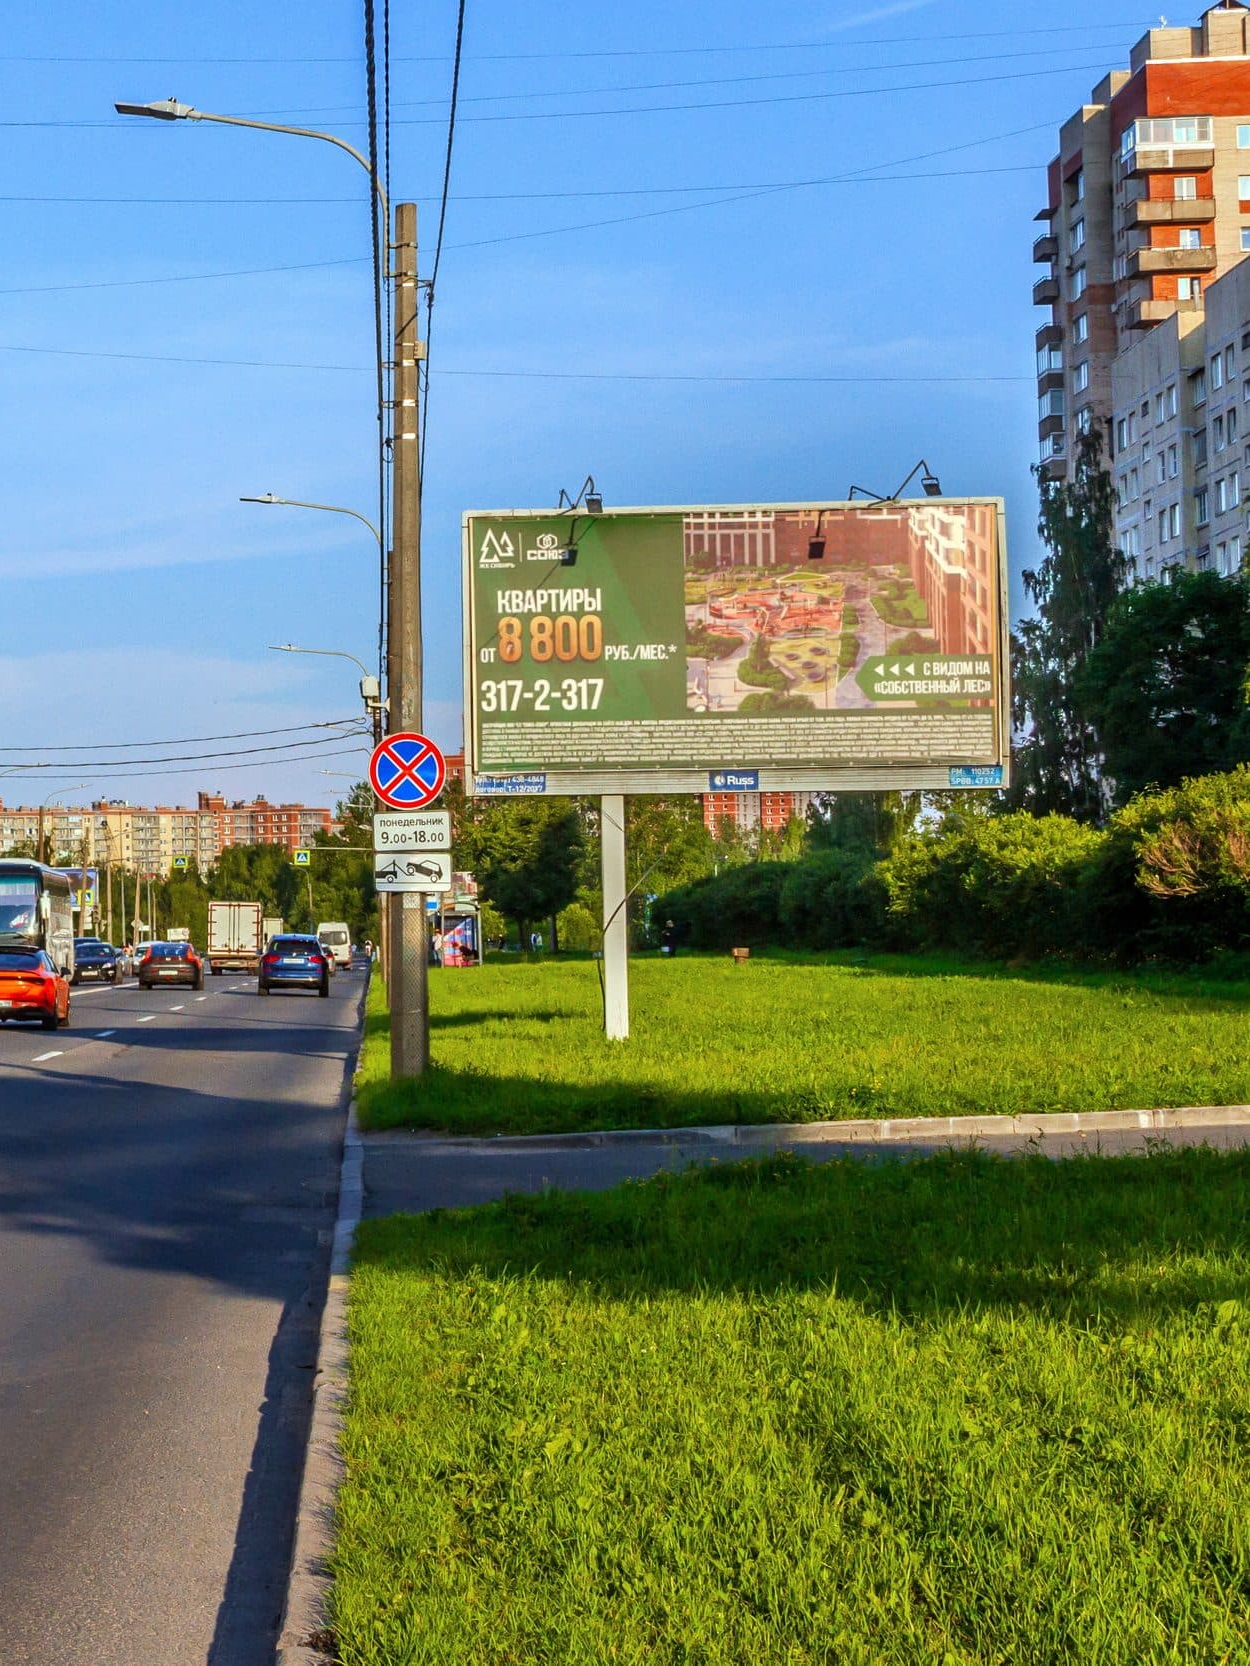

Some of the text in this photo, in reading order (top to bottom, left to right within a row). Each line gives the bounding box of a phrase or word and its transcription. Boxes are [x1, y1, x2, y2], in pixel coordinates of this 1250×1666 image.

[497, 588, 602, 613] КВАРТИРЫ
[480, 648, 496, 663] ОТ
[923, 661, 990, 676] С ВИДОМ НА
[874, 677, 991, 694] «СОБСТВЕННЫЙ ЛЕС»
[481, 678, 604, 712] 317-2-317
[727, 775, 754, 785] Russ
[379, 816, 444, 828] понедельник
[381, 830, 444, 844] 9.00-18.00
